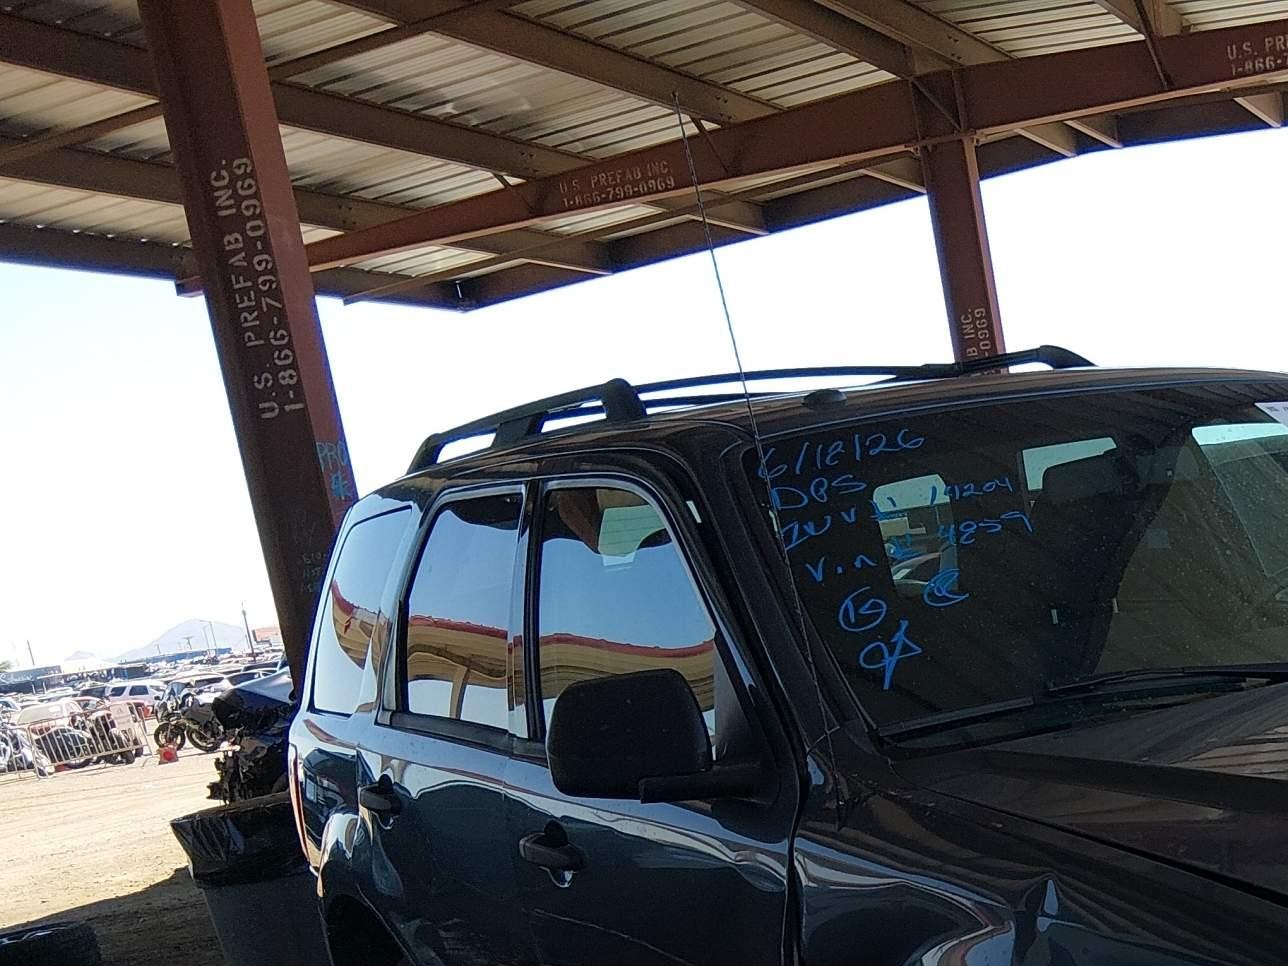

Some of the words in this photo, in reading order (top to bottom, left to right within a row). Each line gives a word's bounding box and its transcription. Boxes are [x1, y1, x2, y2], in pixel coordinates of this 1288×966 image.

[1226, 41, 1258, 60] U.S.
[210, 159, 237, 217] INC.
[559, 179, 580, 194] US
[223, 231, 265, 347] PREFAB
[232, 157, 304, 412] 1-866-799-0969
[254, 363, 280, 420] U.S.
